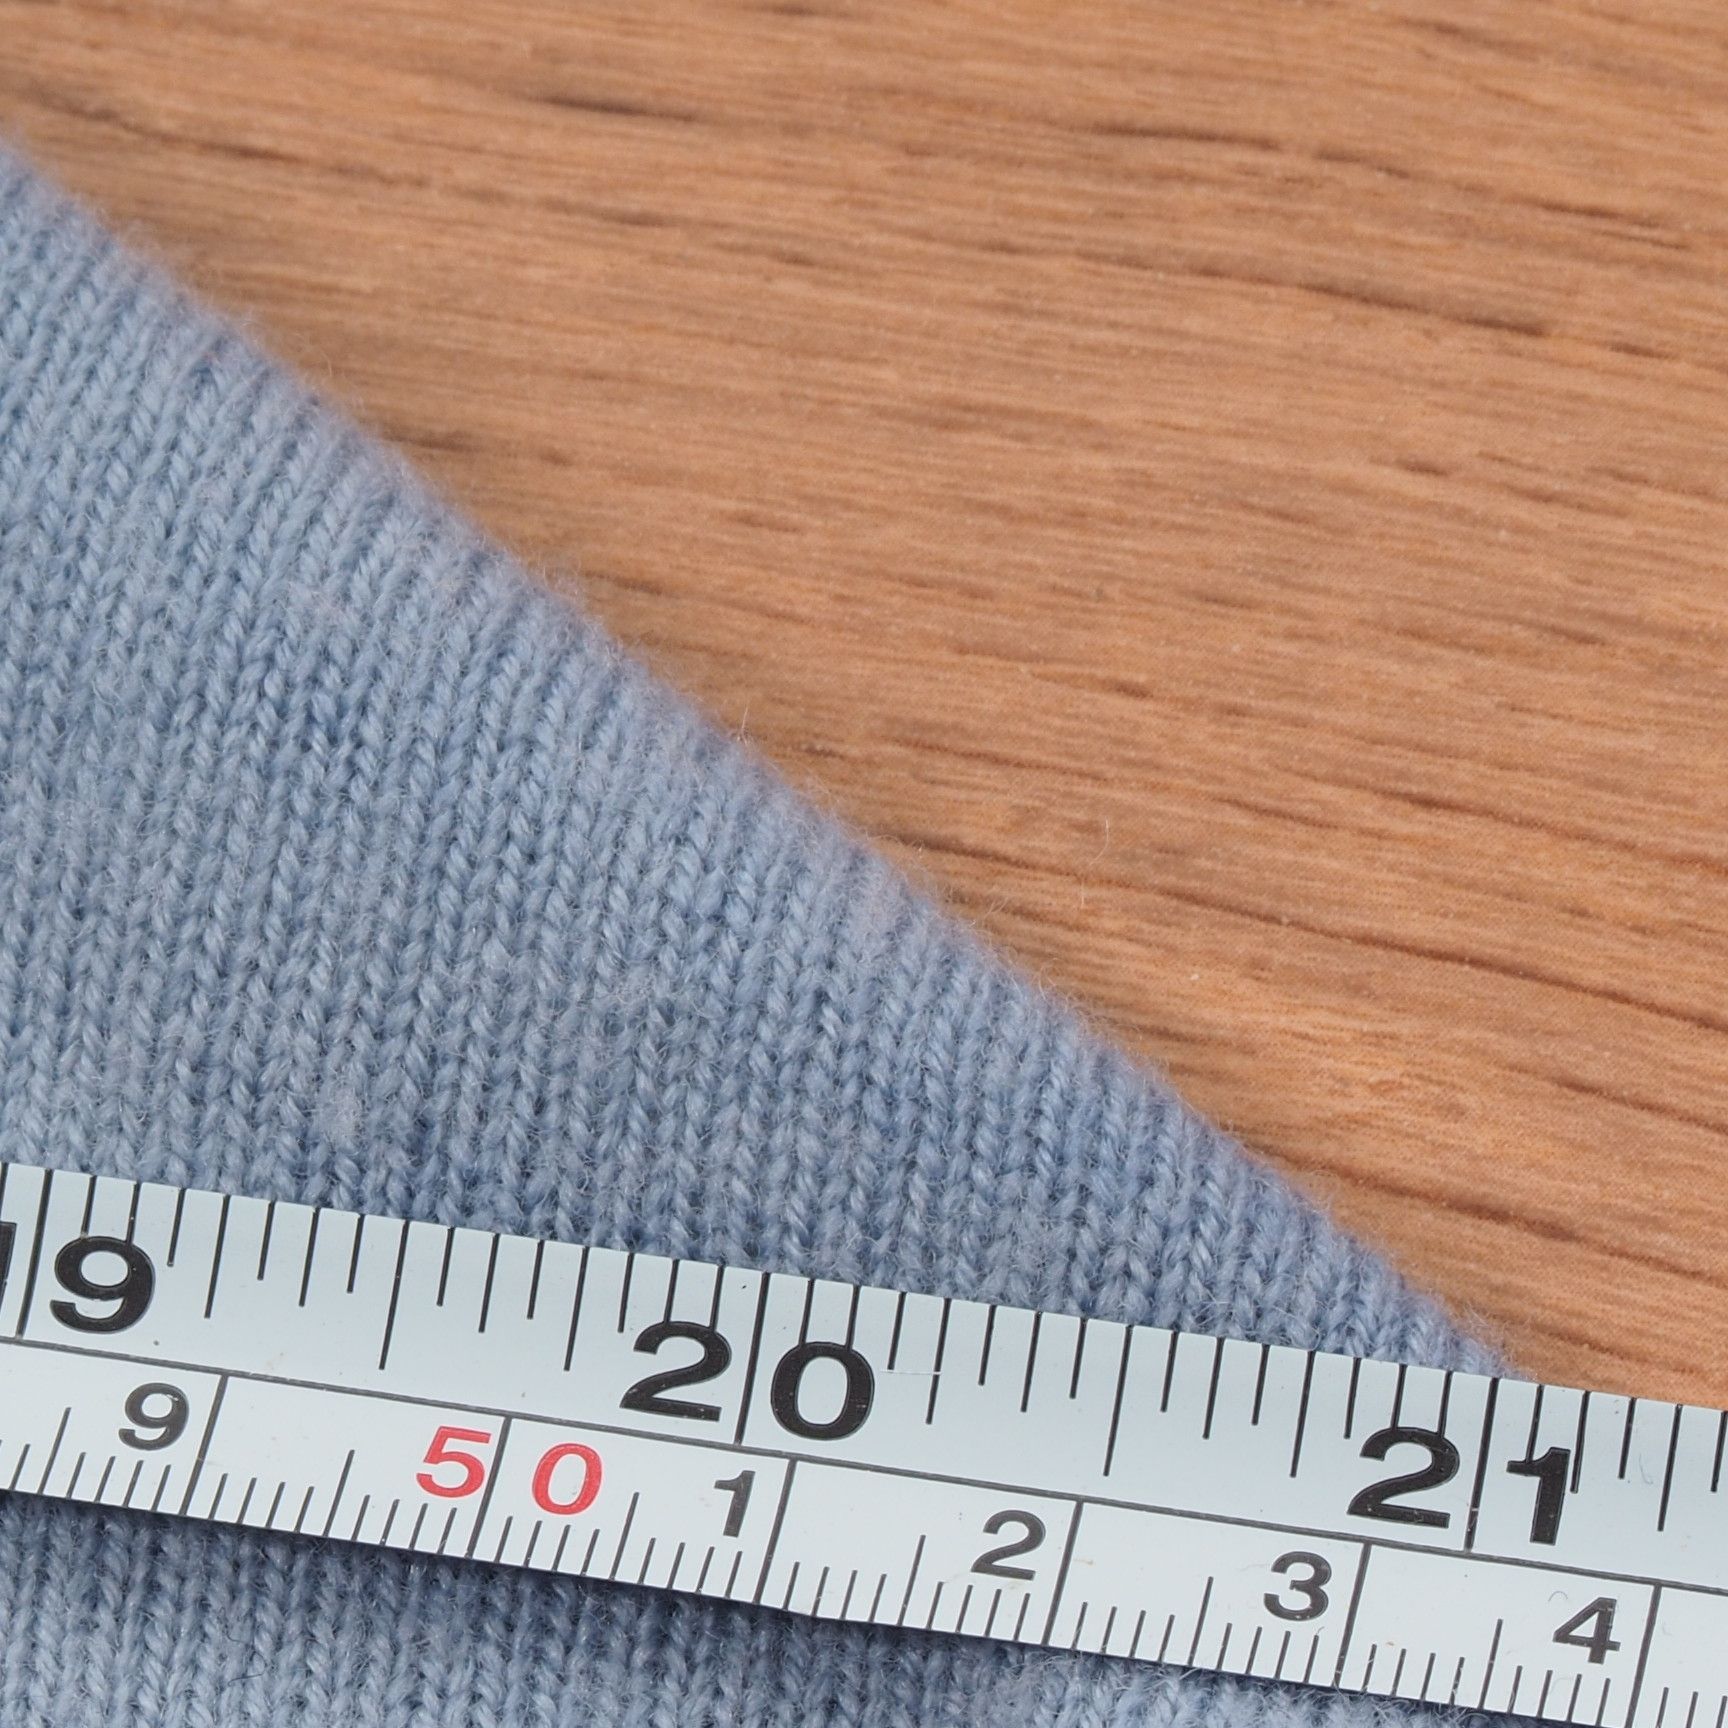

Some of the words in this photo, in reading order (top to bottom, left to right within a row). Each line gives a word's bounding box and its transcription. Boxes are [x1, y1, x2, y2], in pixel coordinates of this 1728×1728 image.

[0, 1222, 155, 1332] 9
[620, 1321, 875, 1440] 20
[1348, 1426, 1571, 1544] 21
[118, 1383, 190, 1450] 9
[416, 1425, 603, 1515] 50
[714, 1470, 756, 1537] 1
[971, 1509, 1045, 1580] 2
[1263, 1551, 1331, 1620] 3
[1553, 1597, 1621, 1663] 4
